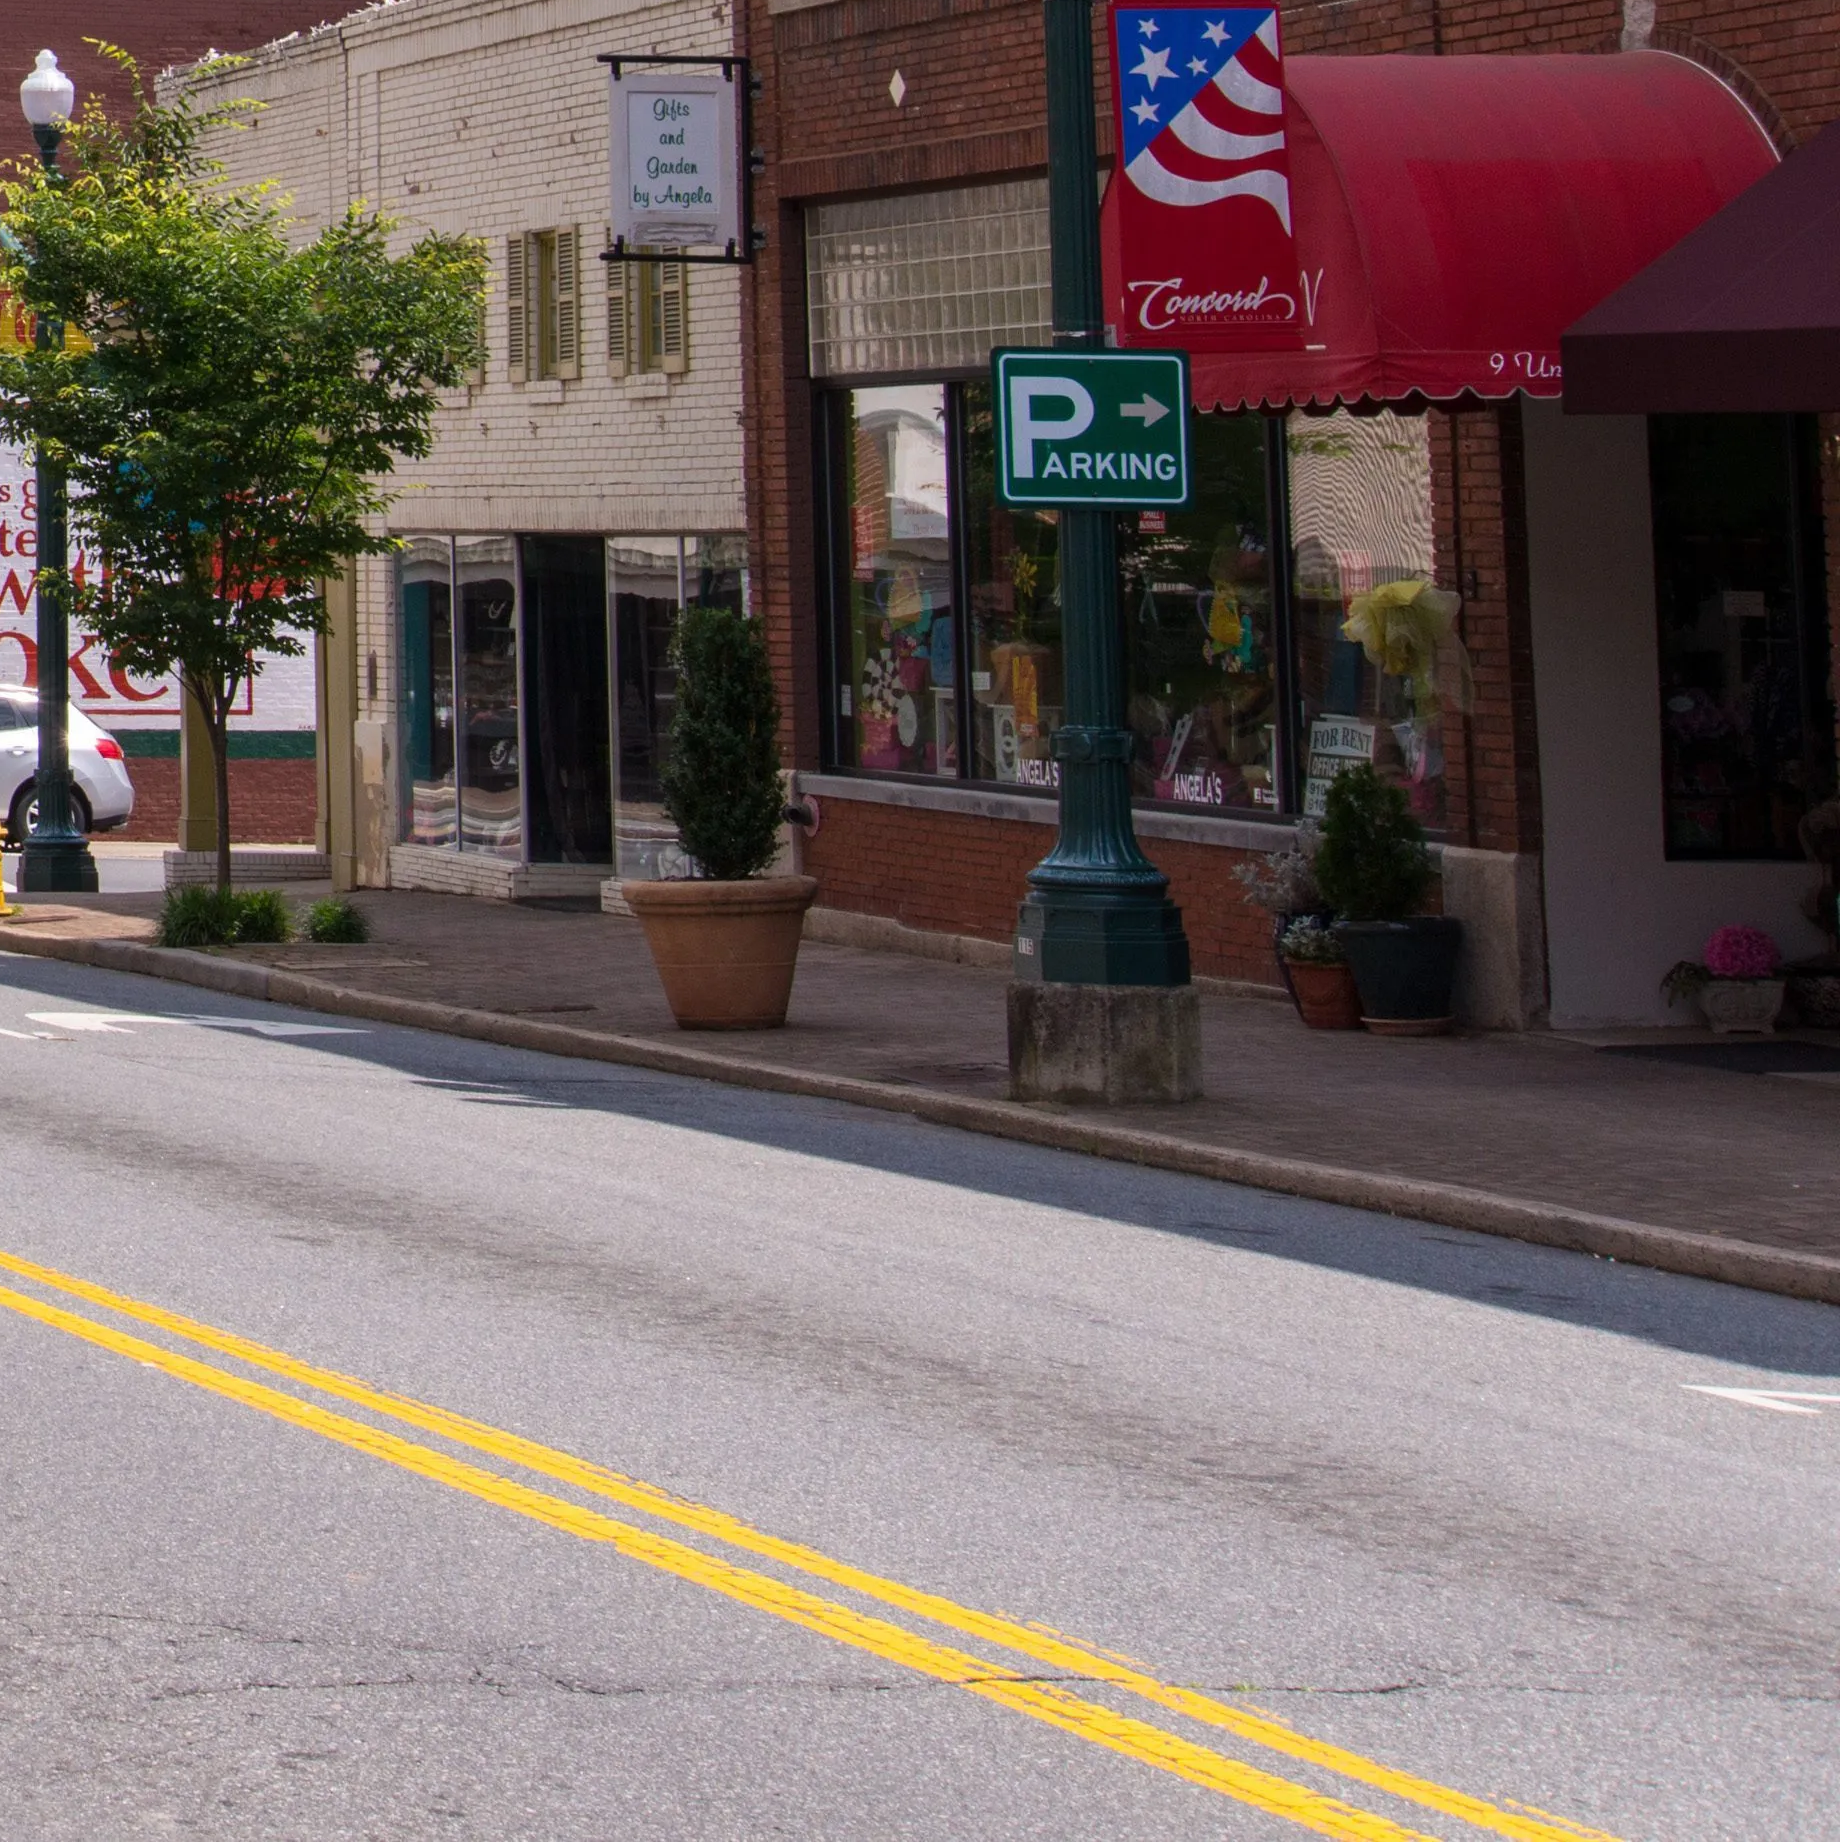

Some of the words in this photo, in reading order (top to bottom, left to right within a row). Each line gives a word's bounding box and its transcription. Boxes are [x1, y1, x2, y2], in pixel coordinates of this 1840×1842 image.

[653, 98, 690, 121] Gifts
[659, 128, 685, 146] and
[646, 156, 698, 179] Garden
[633, 185, 650, 207] by
[654, 185, 713, 208] Angela
[1127, 276, 1296, 330] Concord
[1223, 314, 1281, 322] CAROLINA
[1489, 352, 1505, 375] 9
[1010, 376, 1177, 480] PARKING
[1312, 727, 1339, 750] FOR
[1341, 726, 1373, 754] RENT
[1015, 758, 1059, 788] ANGELA'S
[1173, 771, 1223, 805] ANGELA'S
